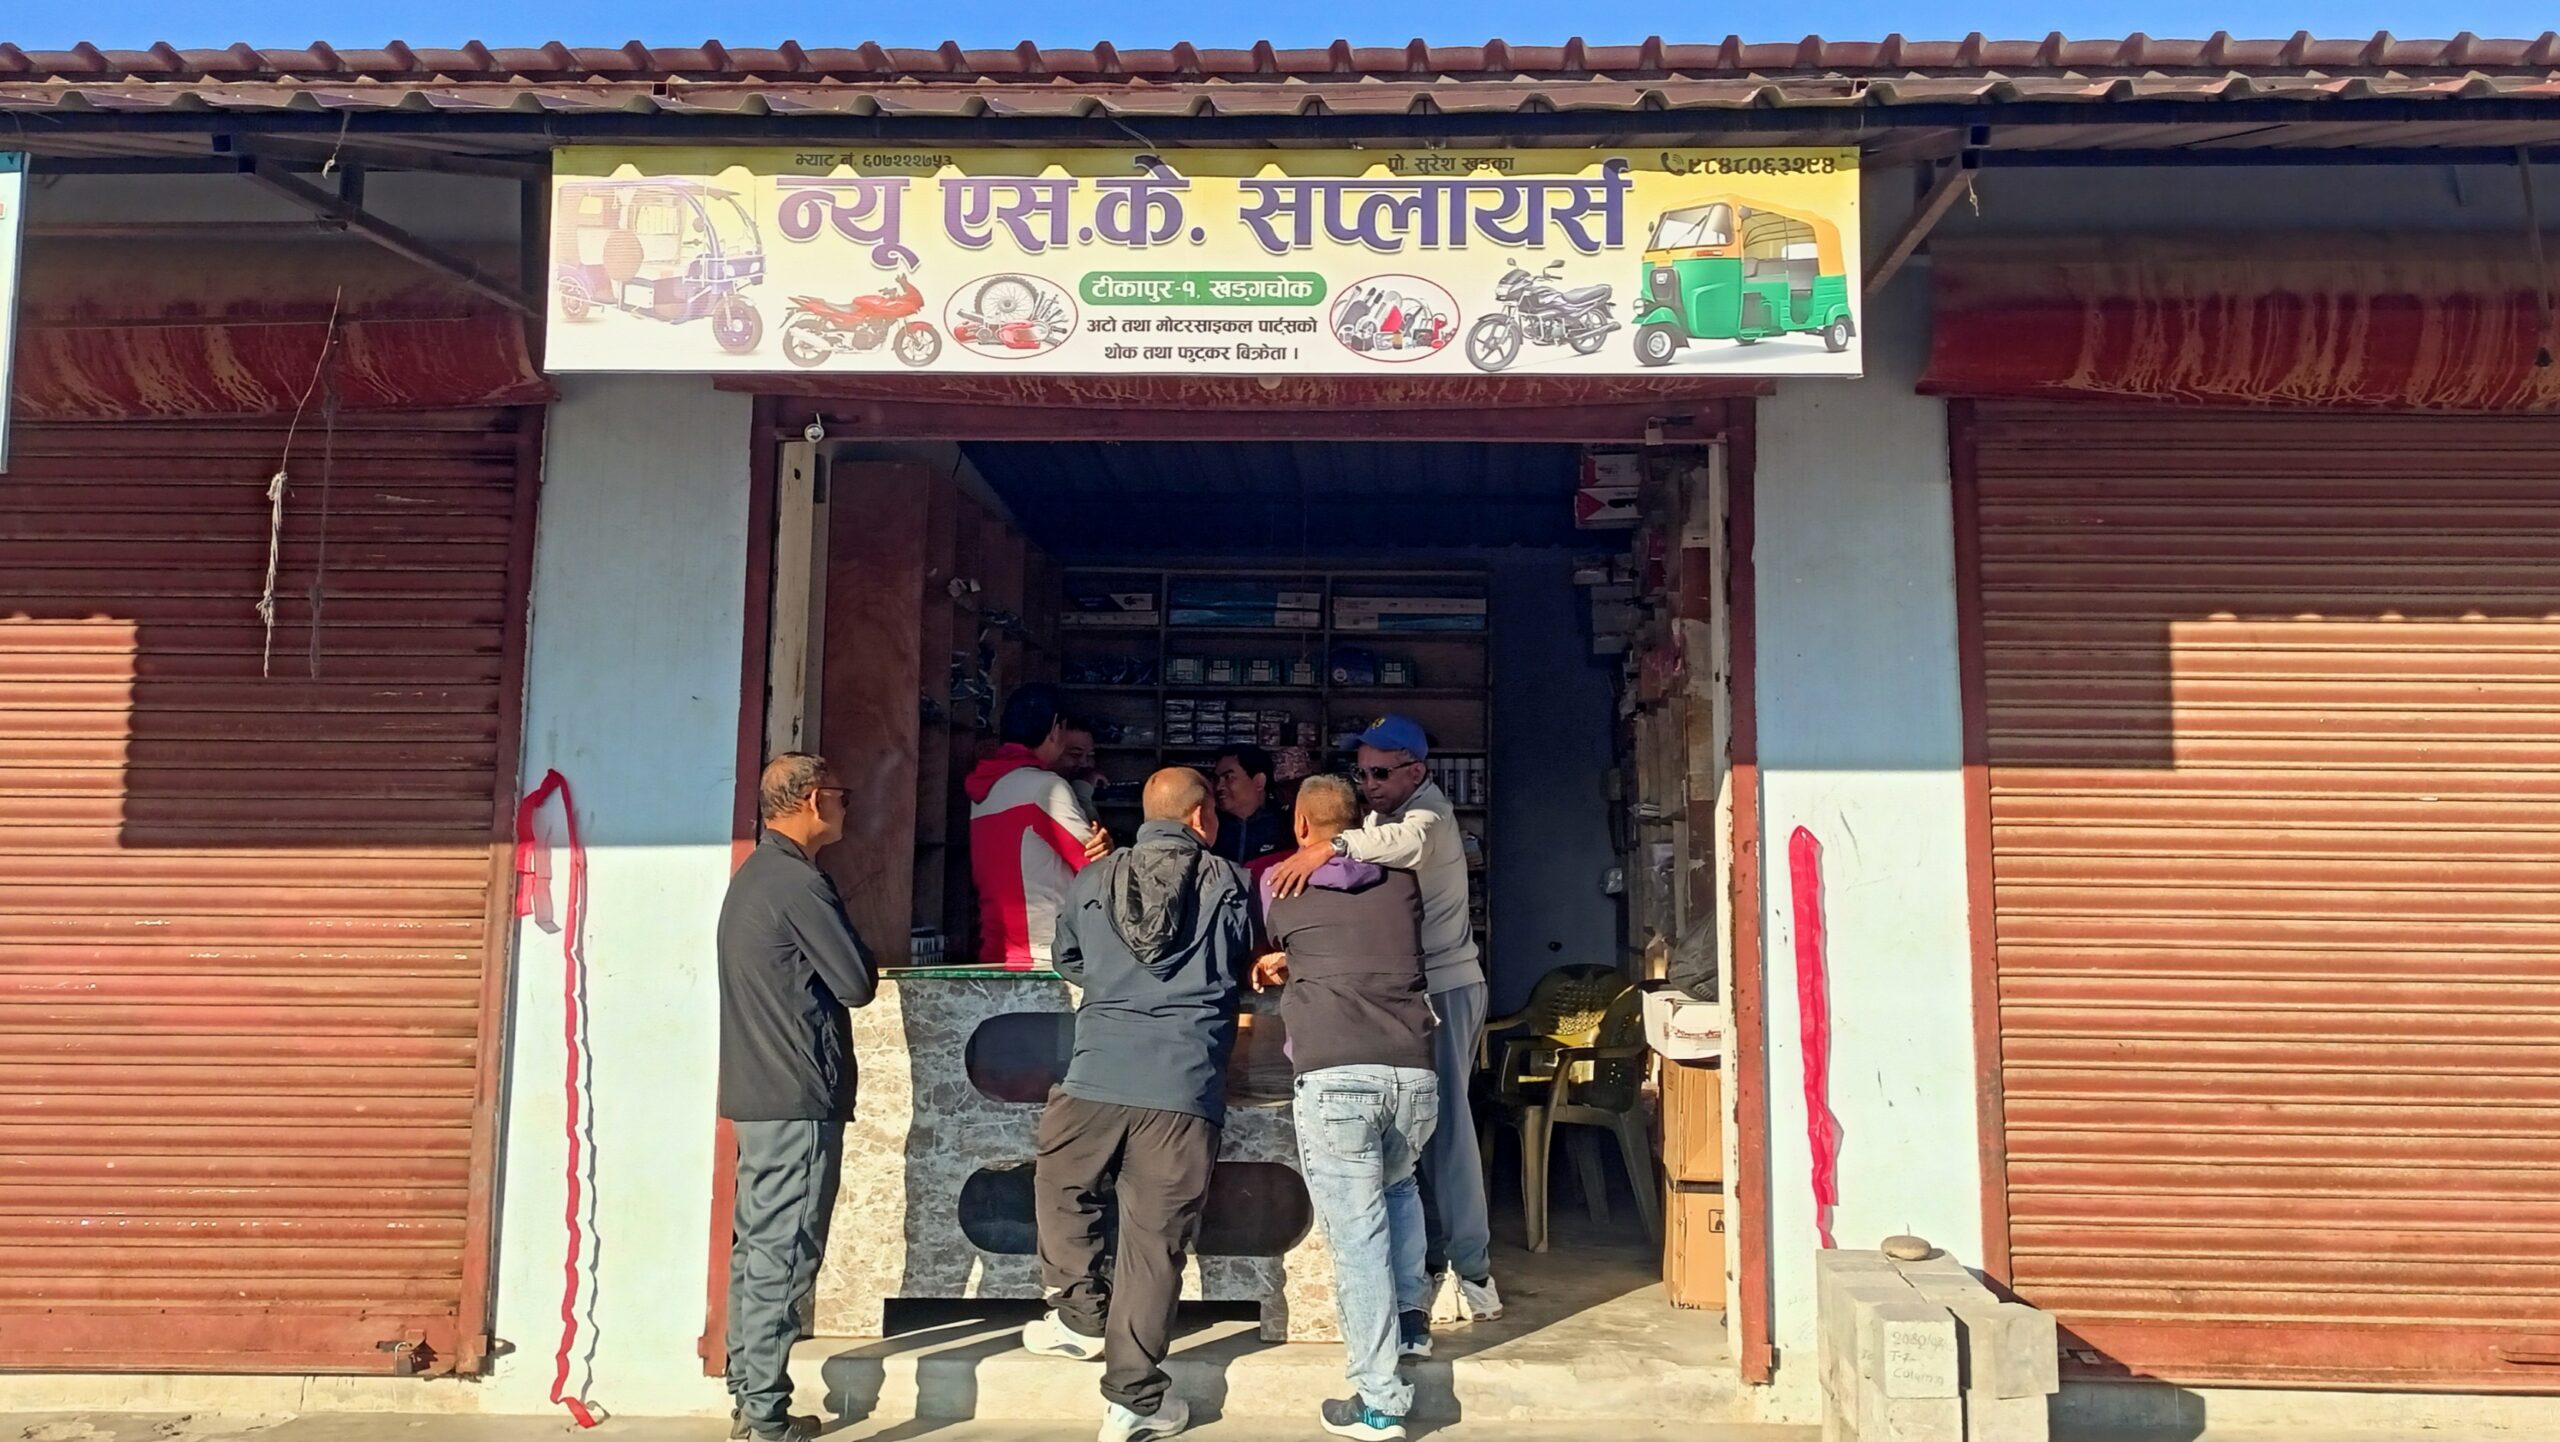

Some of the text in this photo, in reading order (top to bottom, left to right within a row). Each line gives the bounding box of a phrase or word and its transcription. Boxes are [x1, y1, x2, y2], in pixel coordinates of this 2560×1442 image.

[1415, 154, 1456, 175] सुरेश
[776, 154, 1633, 270] न्यू एस.के. सप्लायर्स
[1092, 275, 1314, 303] टीकापुर-१, खड्गचोक
[1087, 316, 1116, 333] अटो
[1122, 319, 1151, 333] तथा
[1156, 316, 1252, 335] मोटरसाइकल
[1104, 343, 1138, 359] थोक
[1143, 347, 1172, 360] तथा
[1236, 343, 1287, 360] बिक्रेता
